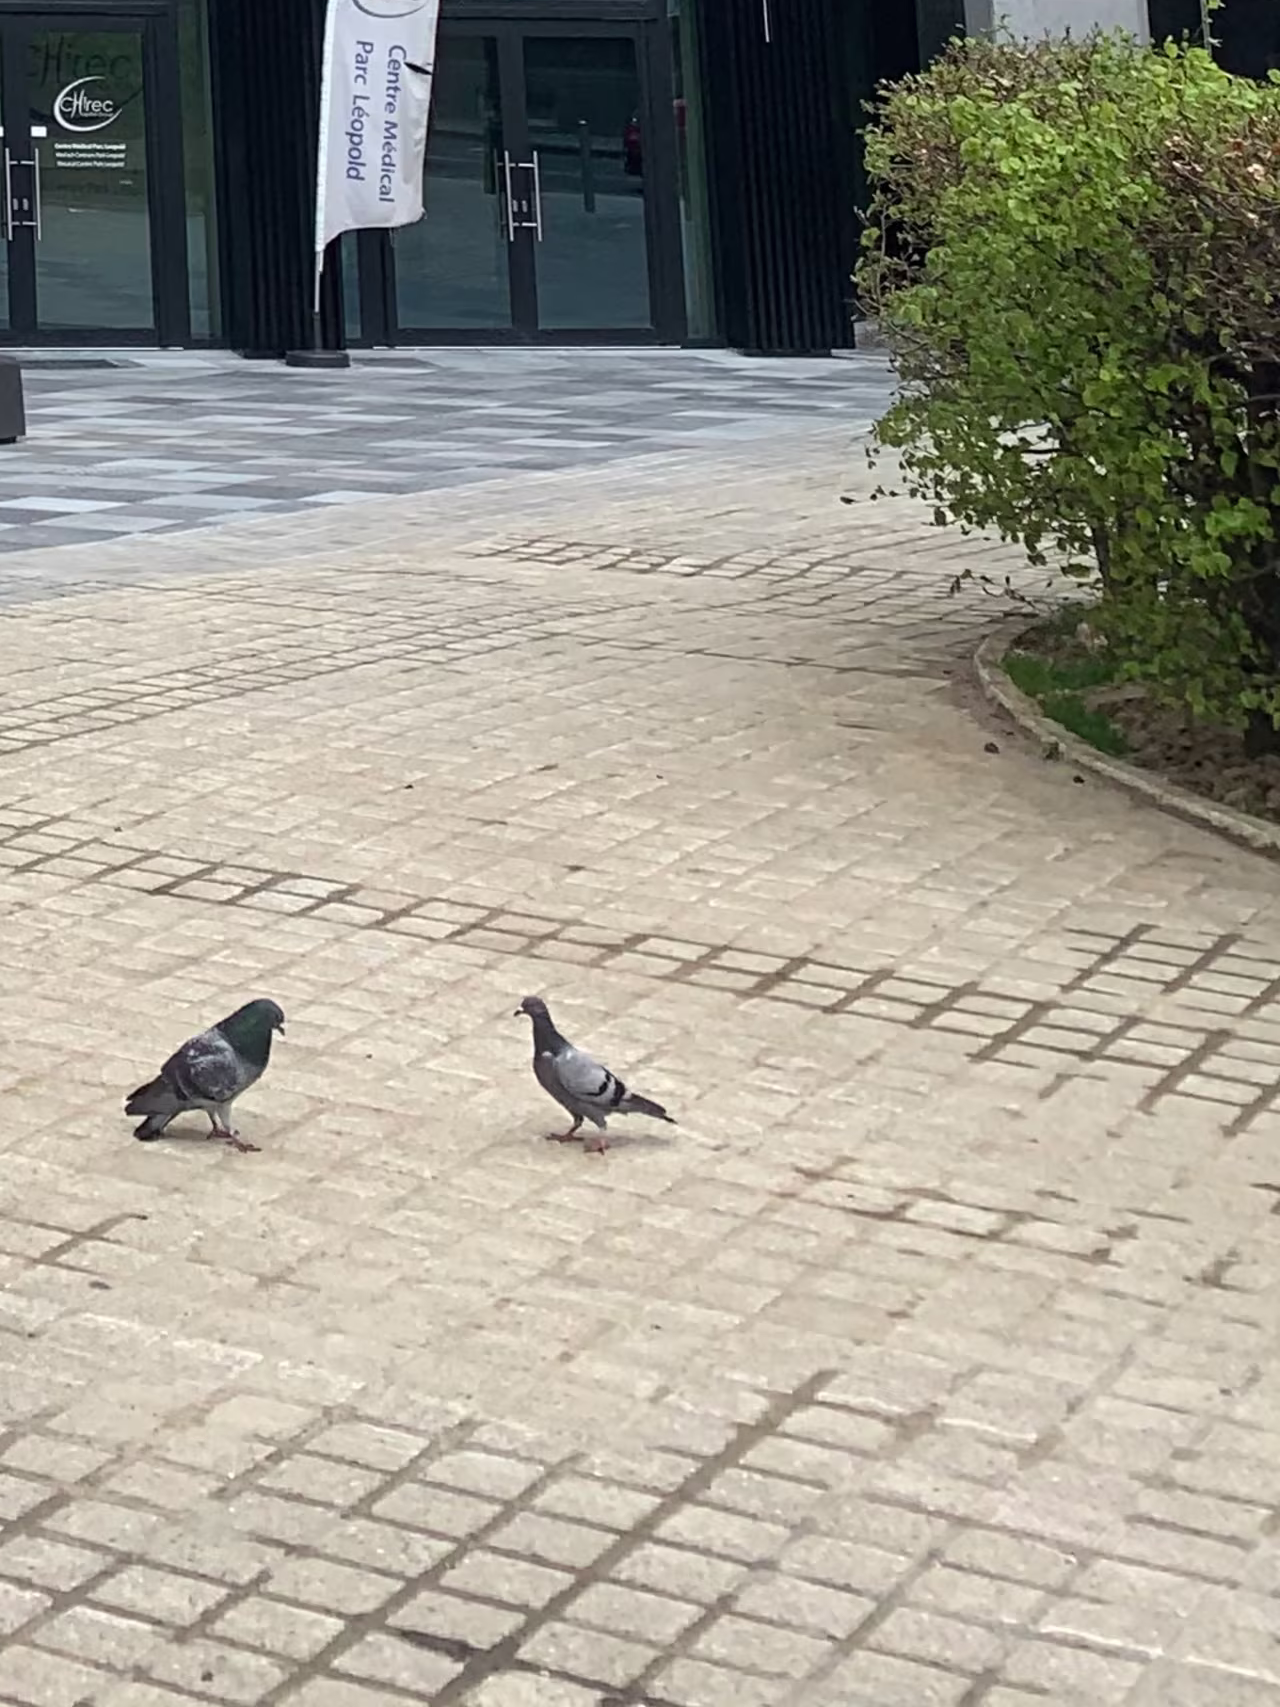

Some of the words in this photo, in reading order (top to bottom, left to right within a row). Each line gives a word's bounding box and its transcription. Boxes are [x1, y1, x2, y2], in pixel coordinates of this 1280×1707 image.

[353, 40, 374, 85] Parc
[384, 44, 407, 115] Centre
[345, 94, 371, 182] Léopold
[378, 117, 398, 203] Médical
